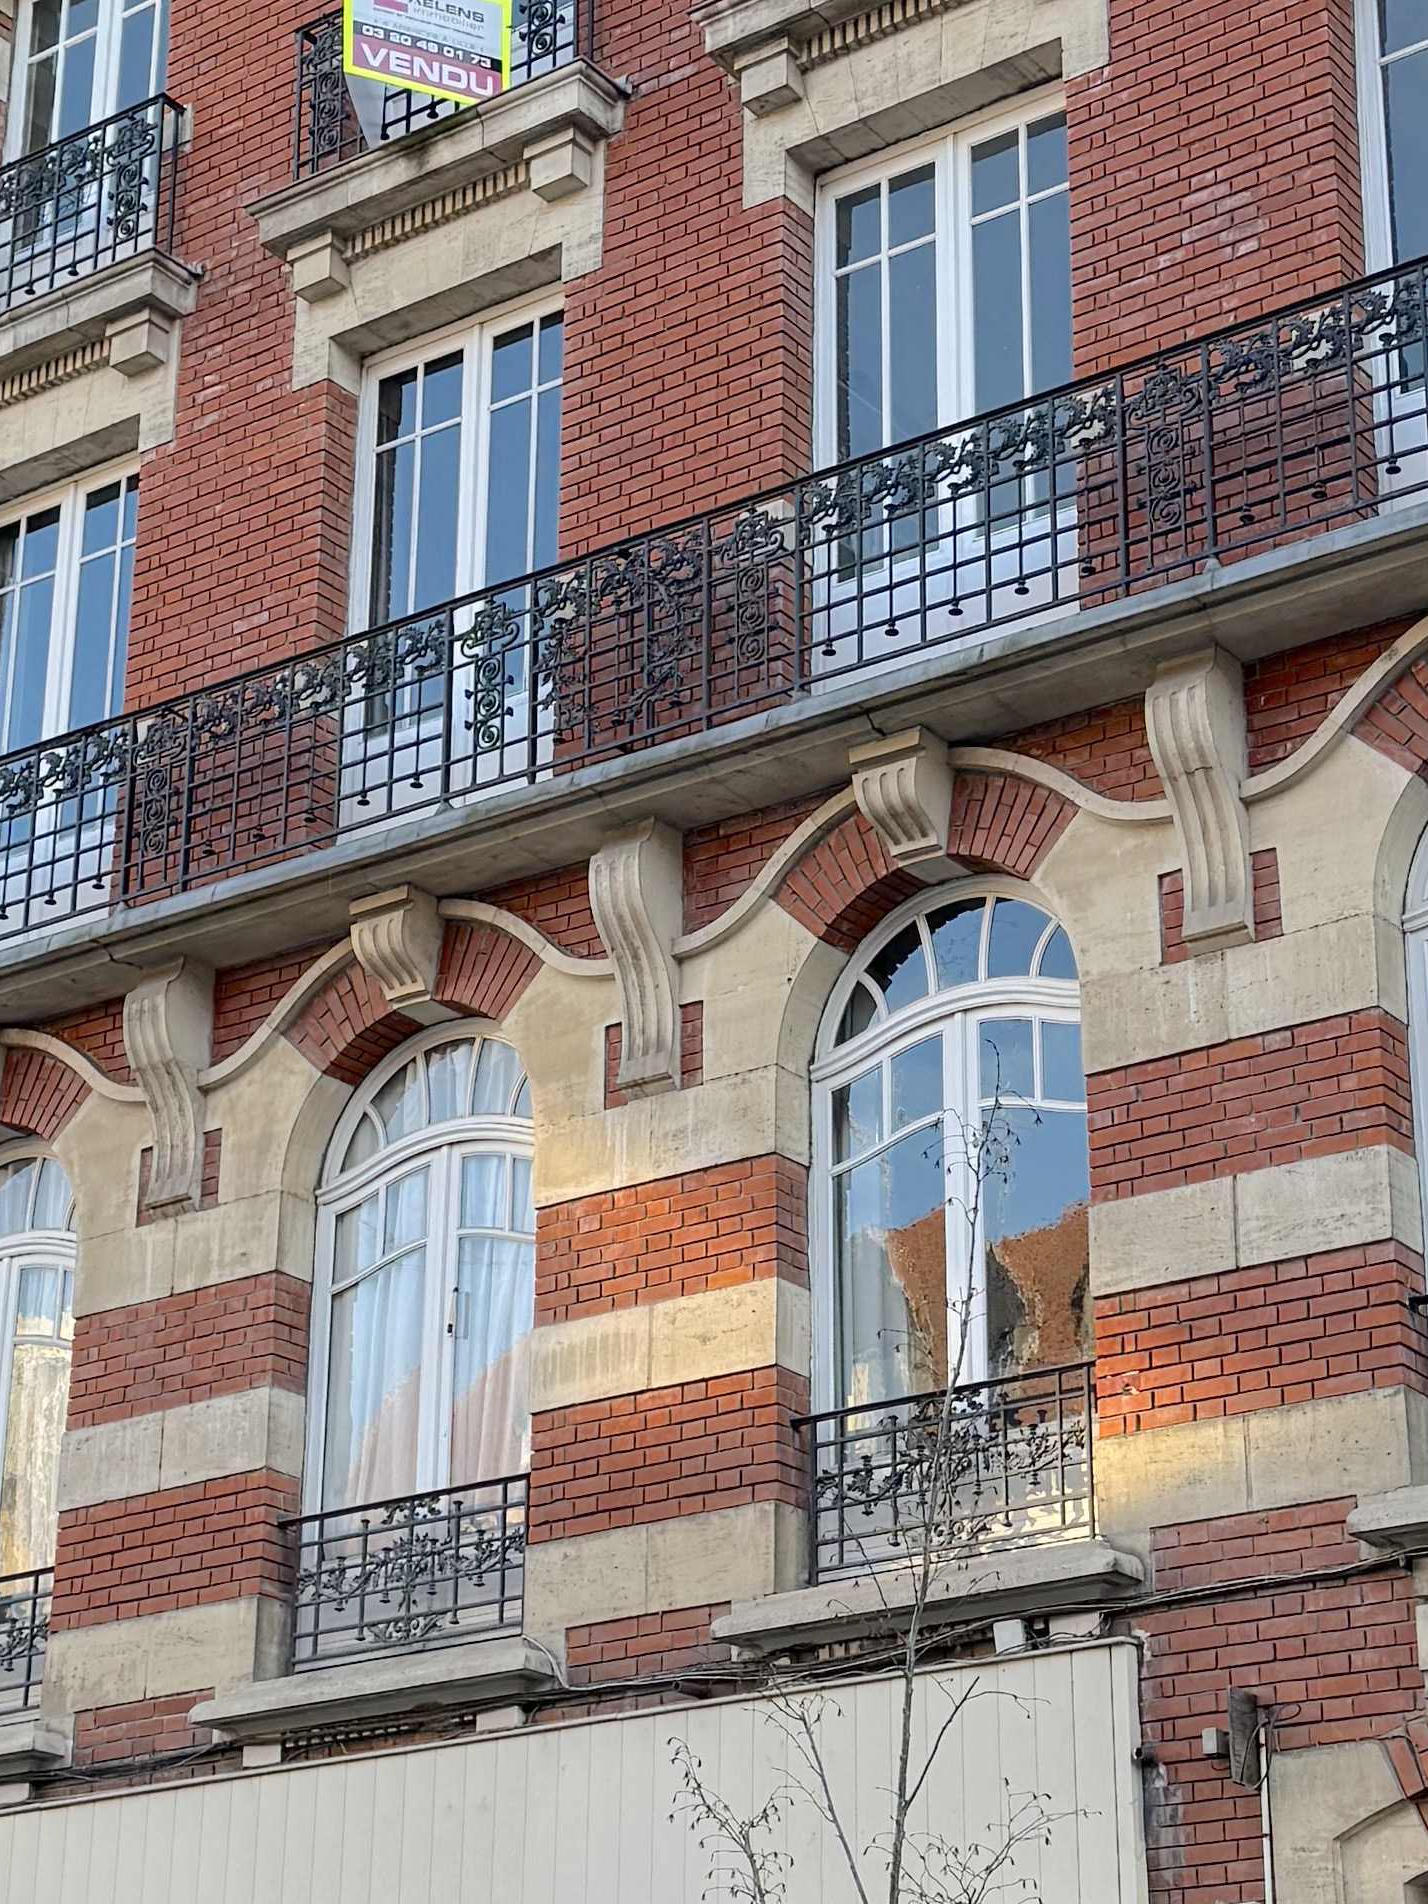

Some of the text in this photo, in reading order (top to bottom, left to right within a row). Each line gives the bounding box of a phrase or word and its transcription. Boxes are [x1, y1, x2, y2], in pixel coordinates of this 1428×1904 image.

[360, 42, 494, 96] VENDU
[361, 25, 384, 39] 03
[443, 48, 464, 61] 01
[470, 54, 492, 68] 73
